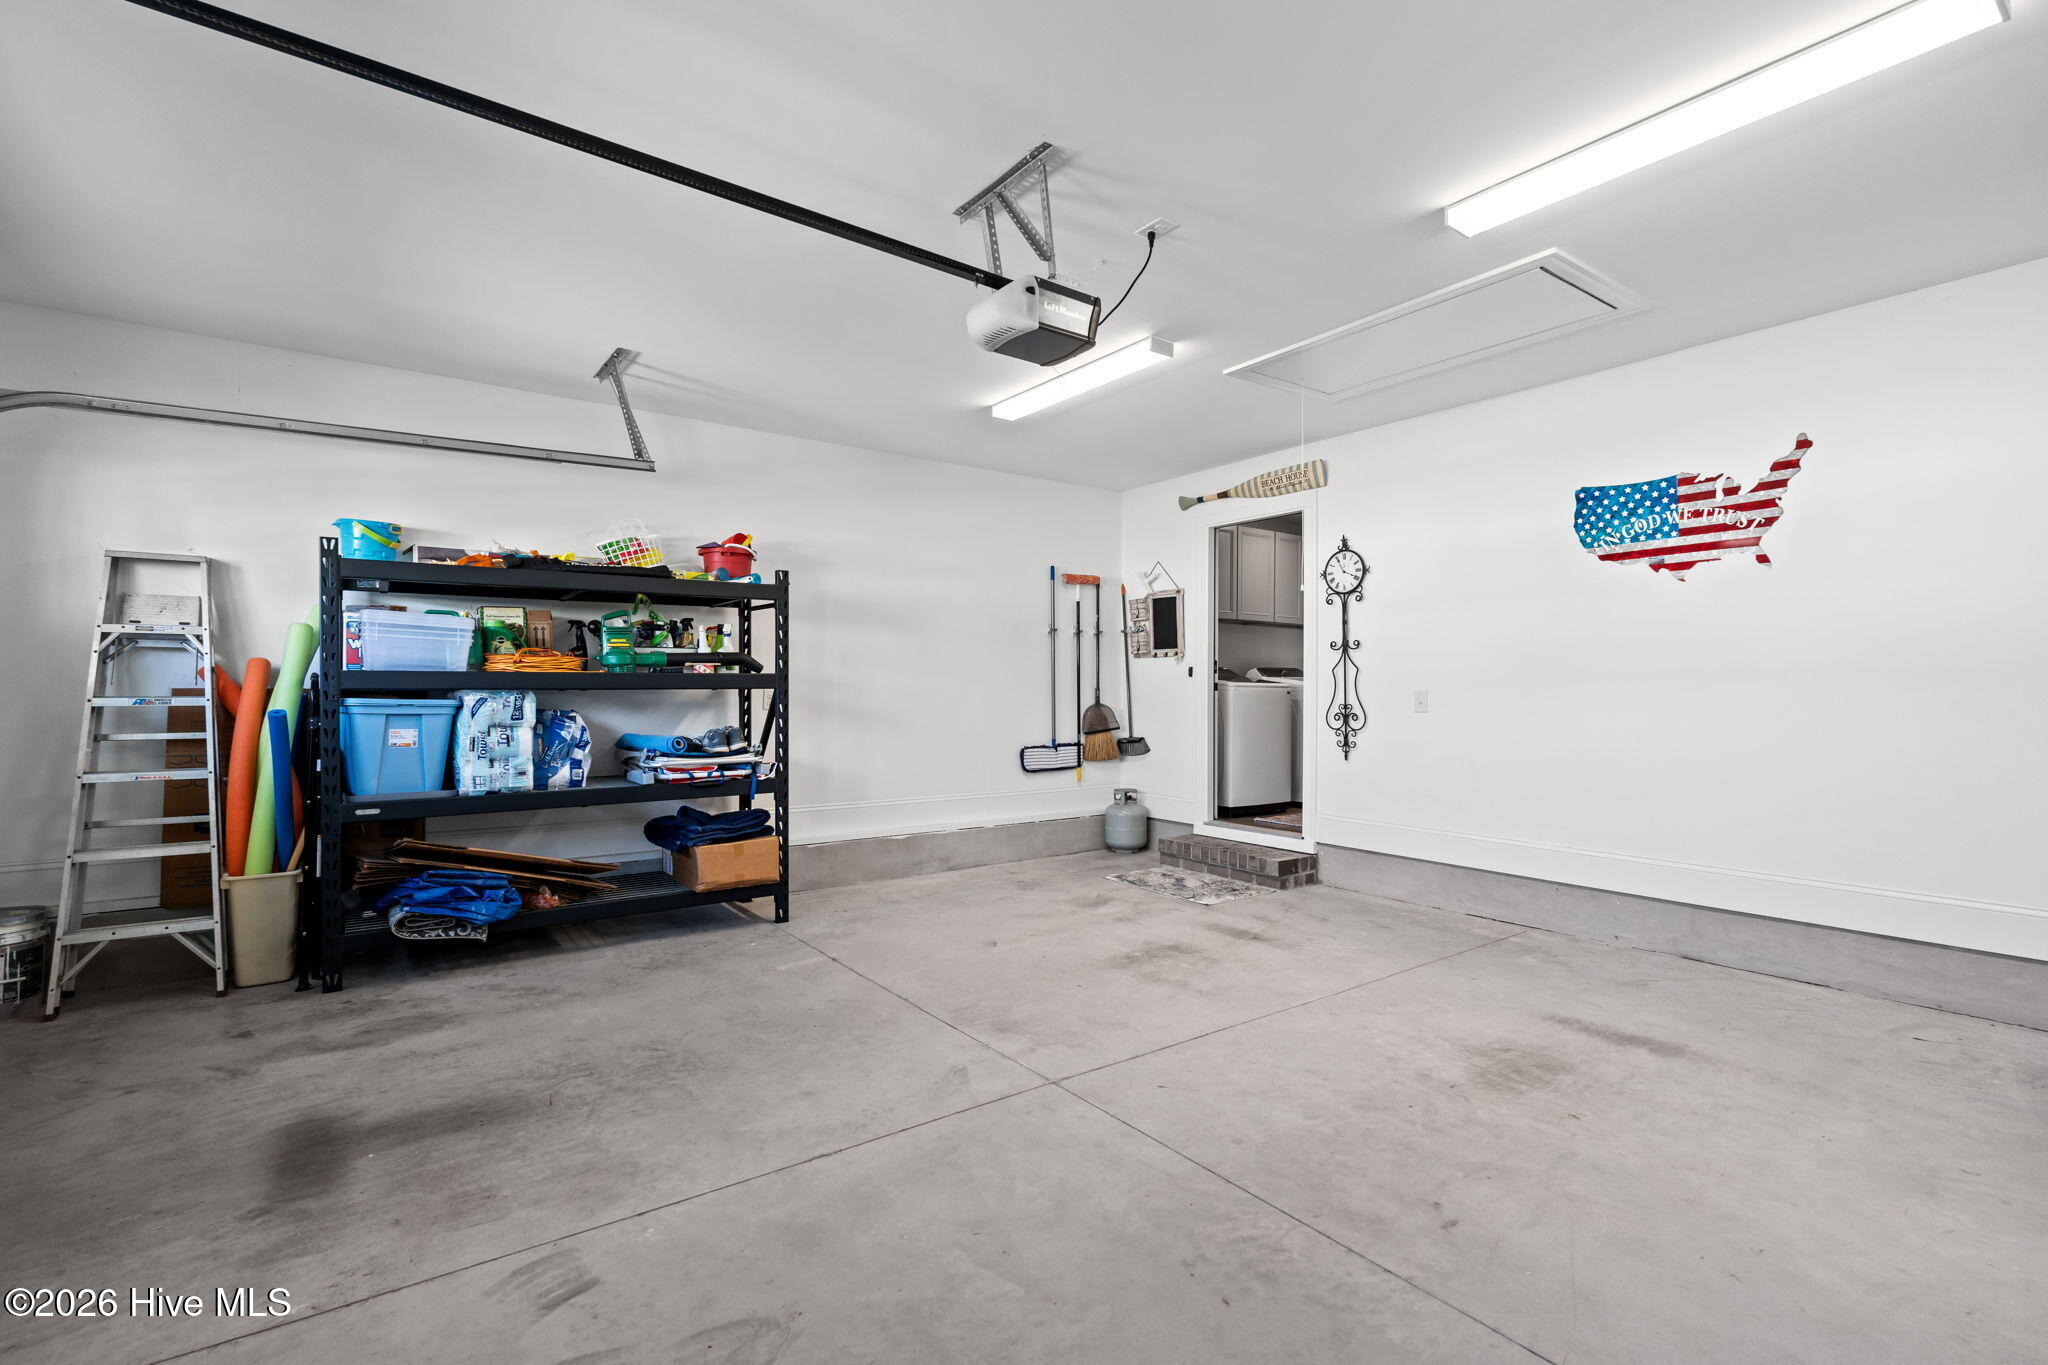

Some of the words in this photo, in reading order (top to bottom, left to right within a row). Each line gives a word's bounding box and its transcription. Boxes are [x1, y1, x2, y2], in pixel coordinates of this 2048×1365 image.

[1044, 300, 1087, 321] LiftMaster
[1261, 476, 1284, 488] BEACH
[1285, 470, 1309, 482] HOUSE
[1599, 532, 1621, 551] IN
[1622, 514, 1661, 538] GOD
[1665, 508, 1694, 525] WE
[1699, 507, 1765, 531] TRUST
[477, 730, 488, 760] Towel
